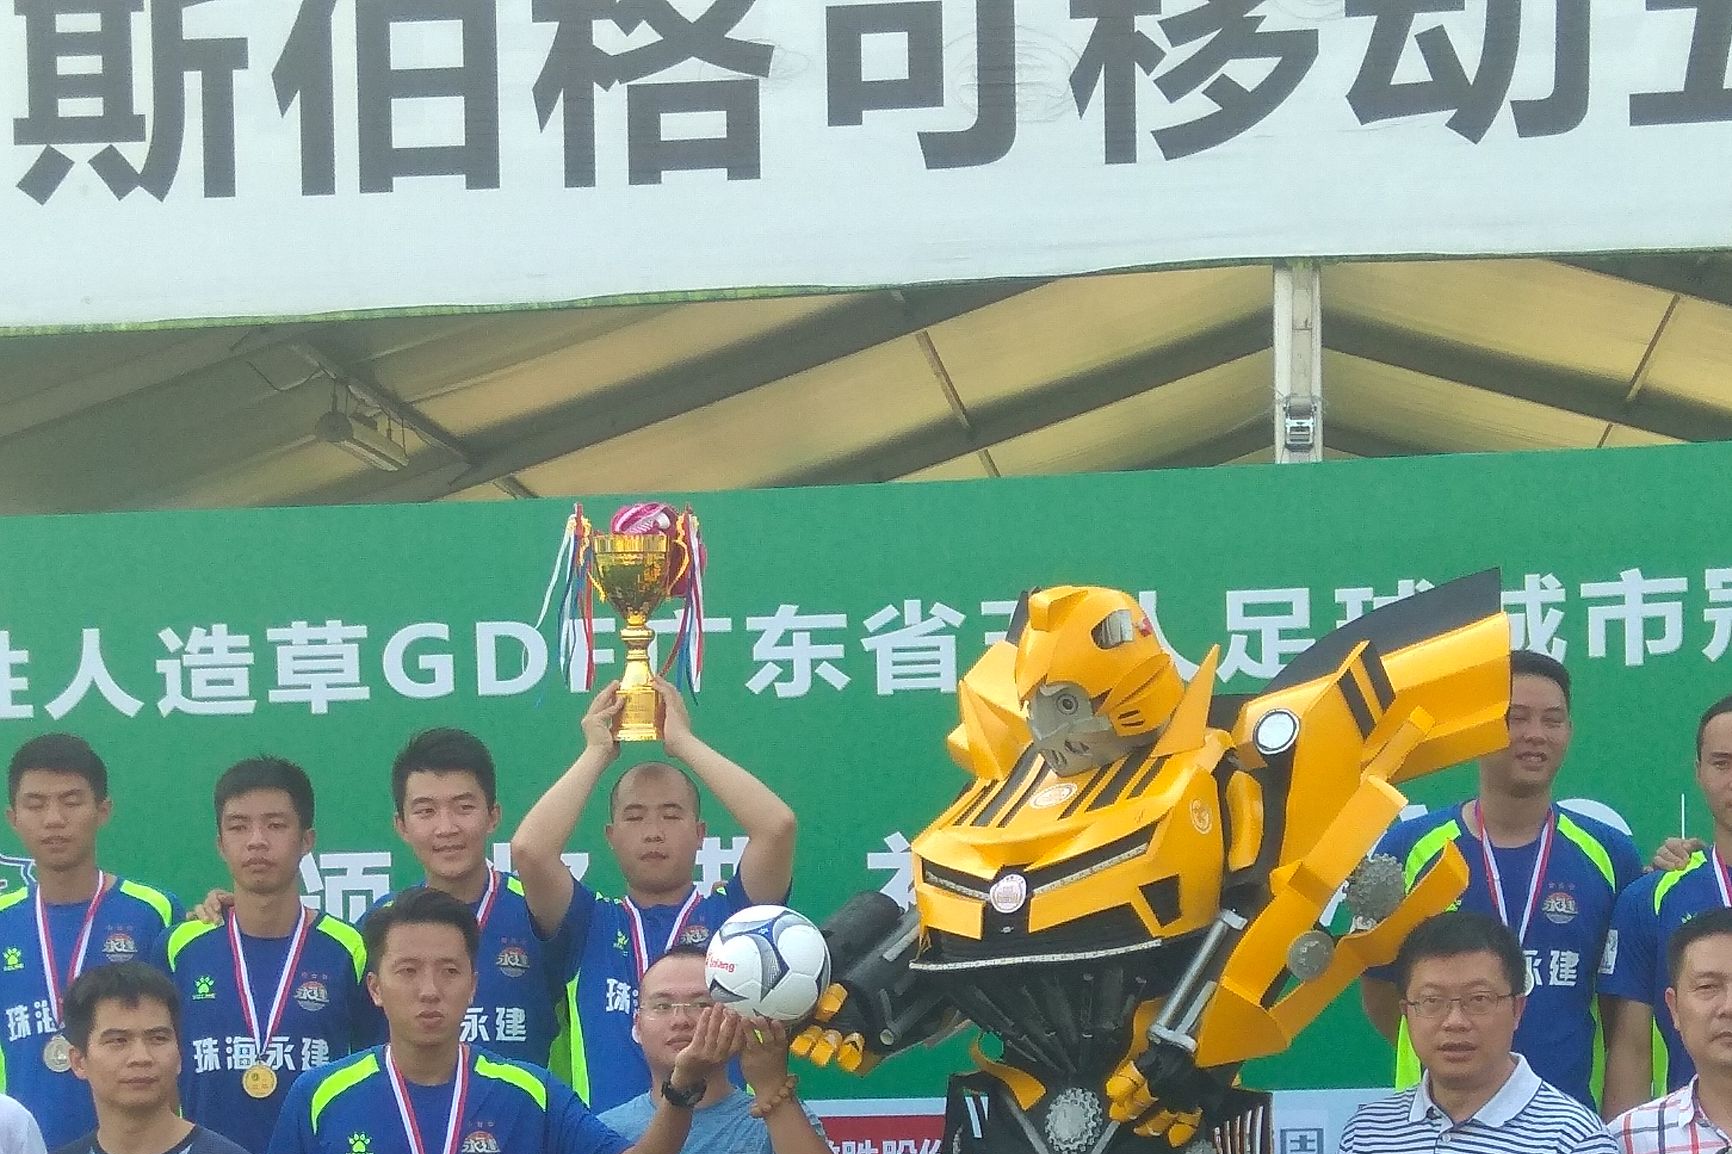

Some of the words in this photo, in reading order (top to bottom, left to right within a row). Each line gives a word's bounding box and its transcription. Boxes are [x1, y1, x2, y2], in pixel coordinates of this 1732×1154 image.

[459, 1006, 527, 1042] 永建
[193, 1035, 330, 1073] 珠海永建
